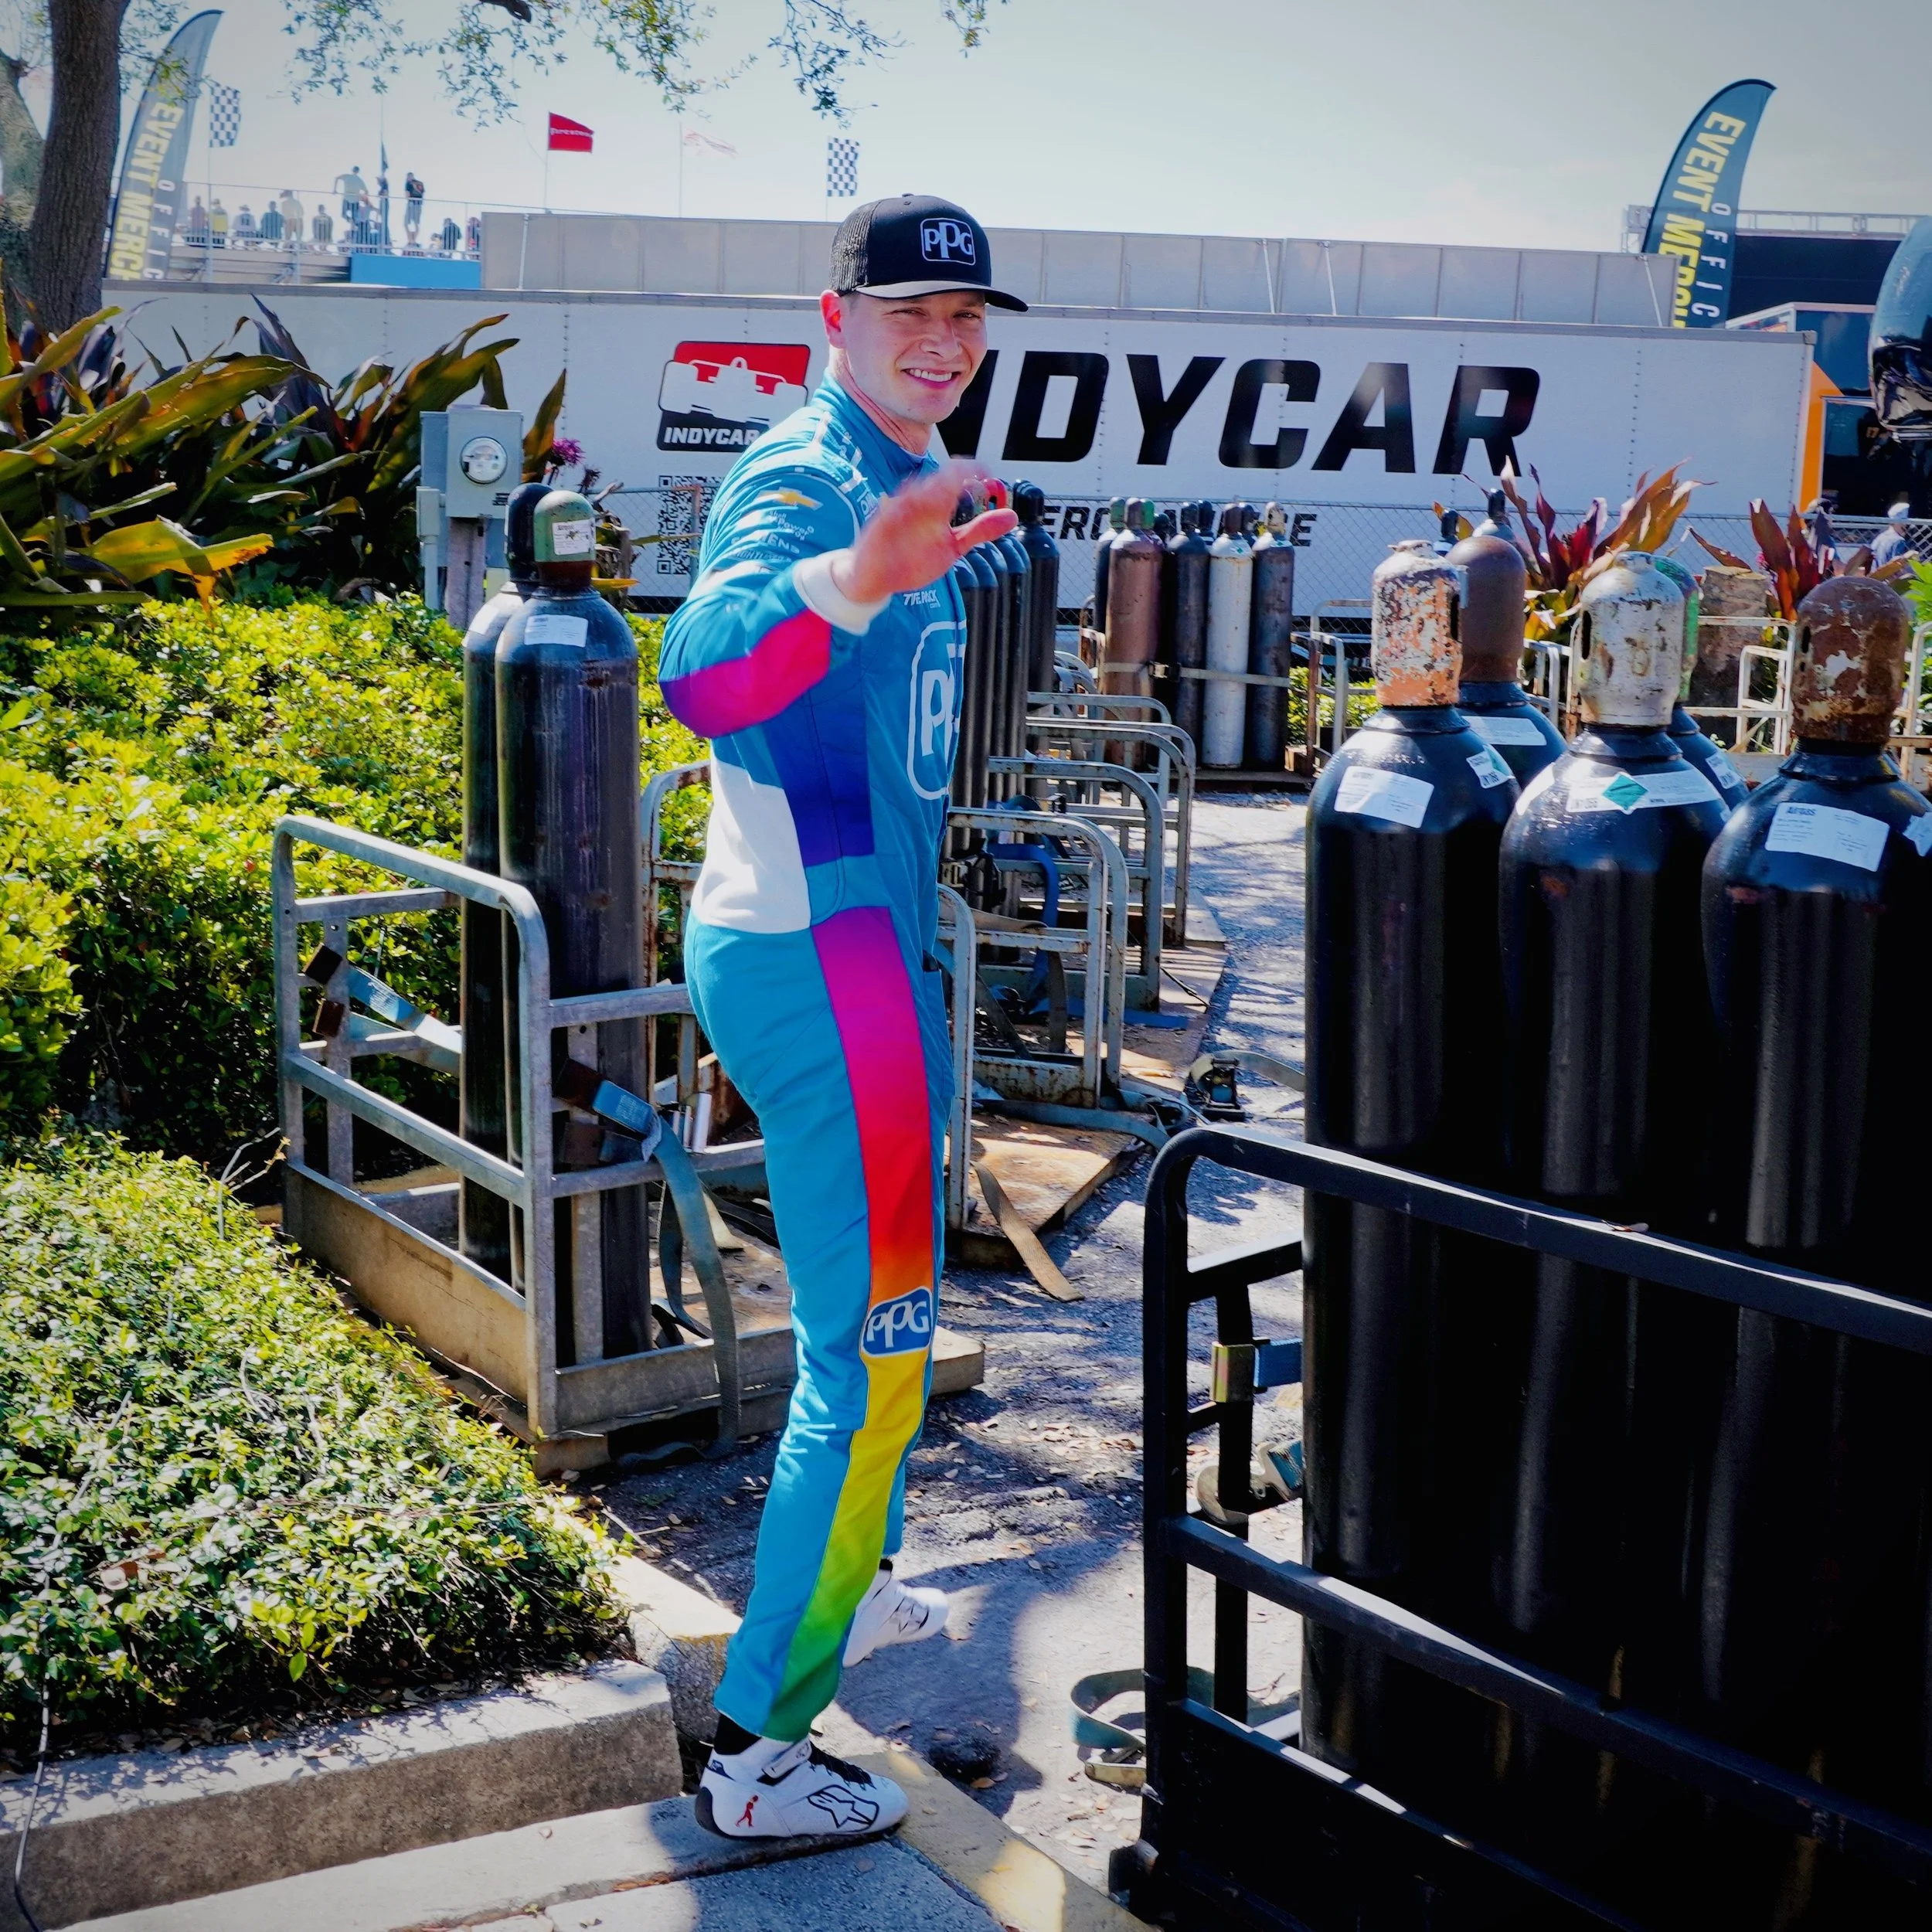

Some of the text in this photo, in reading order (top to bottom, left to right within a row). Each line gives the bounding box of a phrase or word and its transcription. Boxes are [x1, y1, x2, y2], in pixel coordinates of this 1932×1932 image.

[127, 101, 185, 189] EVENT
[1672, 111, 1747, 213] EVENT
[142, 179, 175, 279] OFFIC
[923, 222, 973, 259] PPG
[1691, 202, 1732, 318] OFFIC
[664, 427, 760, 446] INDYCAR
[866, 1300, 930, 1349] PPG
